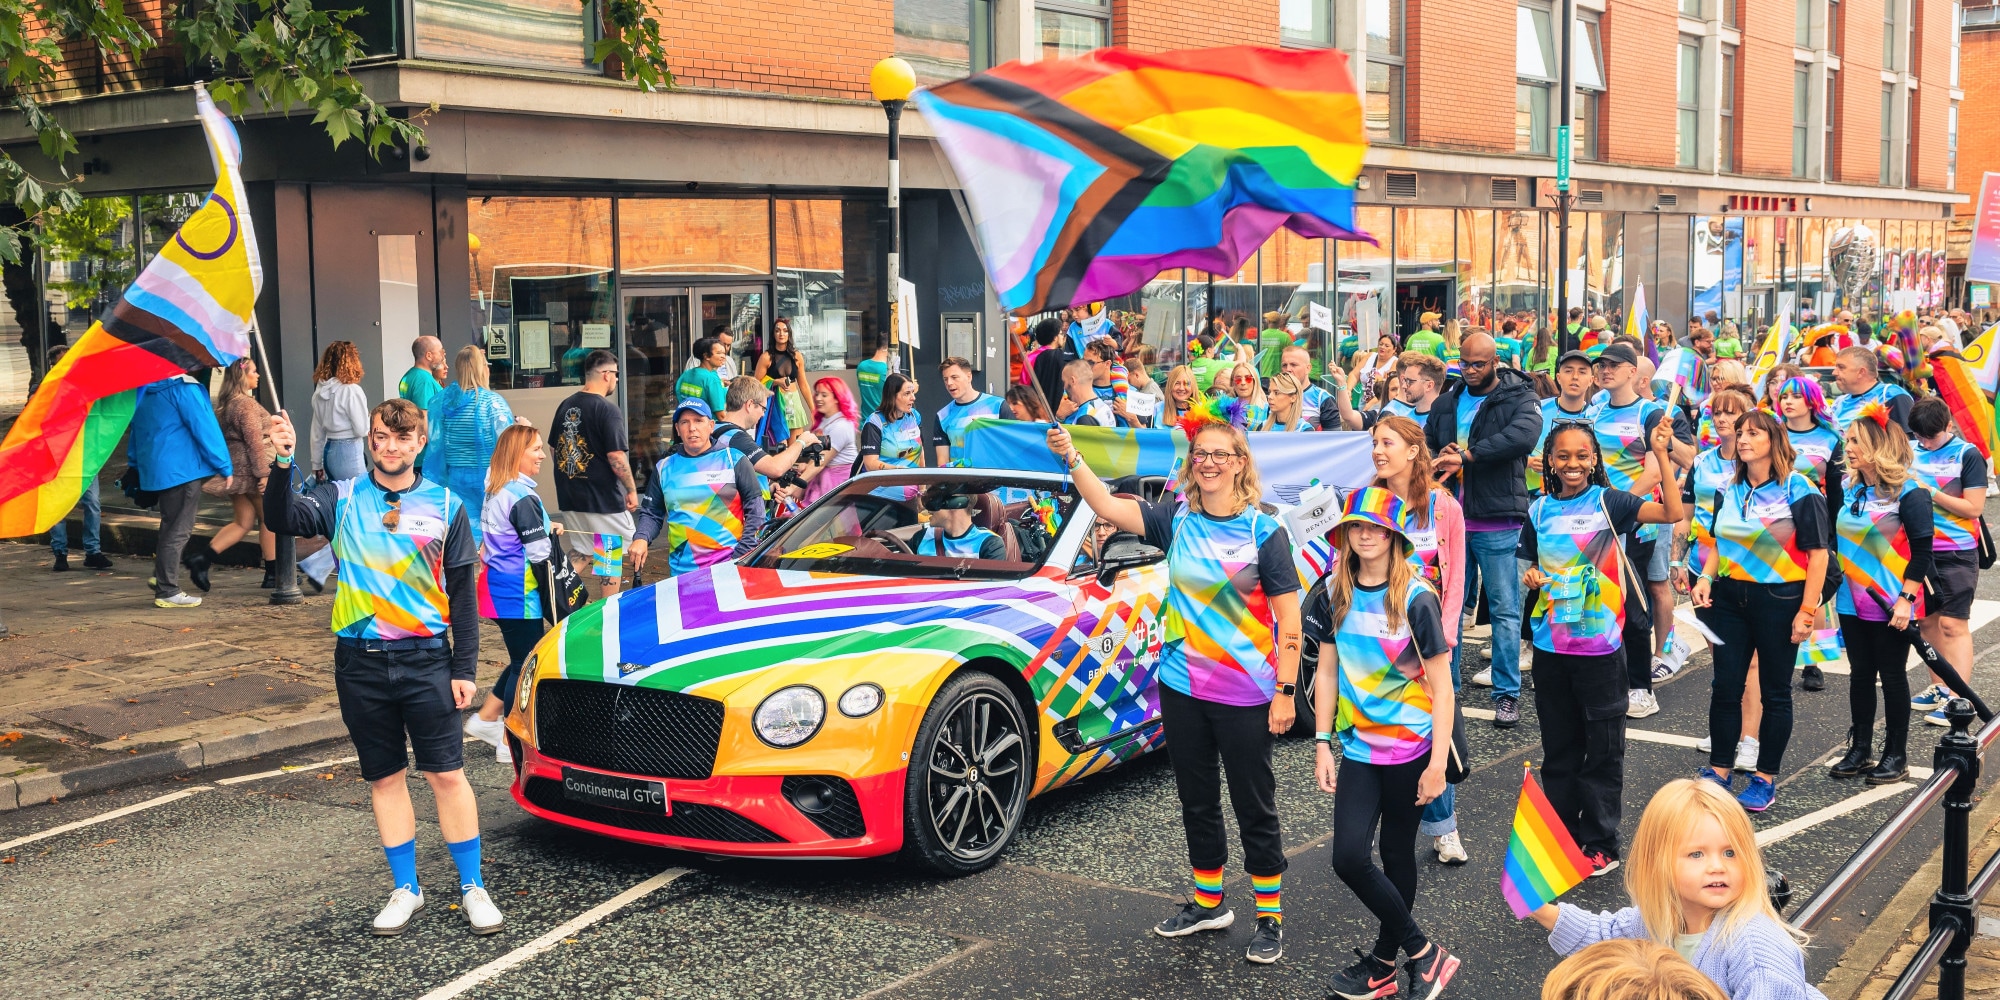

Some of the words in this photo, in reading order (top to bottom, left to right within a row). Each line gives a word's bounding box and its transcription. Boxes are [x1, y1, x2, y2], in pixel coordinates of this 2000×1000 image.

[1305, 513, 1336, 534] BENTLEY
[1088, 661, 1126, 681] BENTLEY
[565, 777, 630, 801] Continental
[633, 789, 661, 805] GTC
